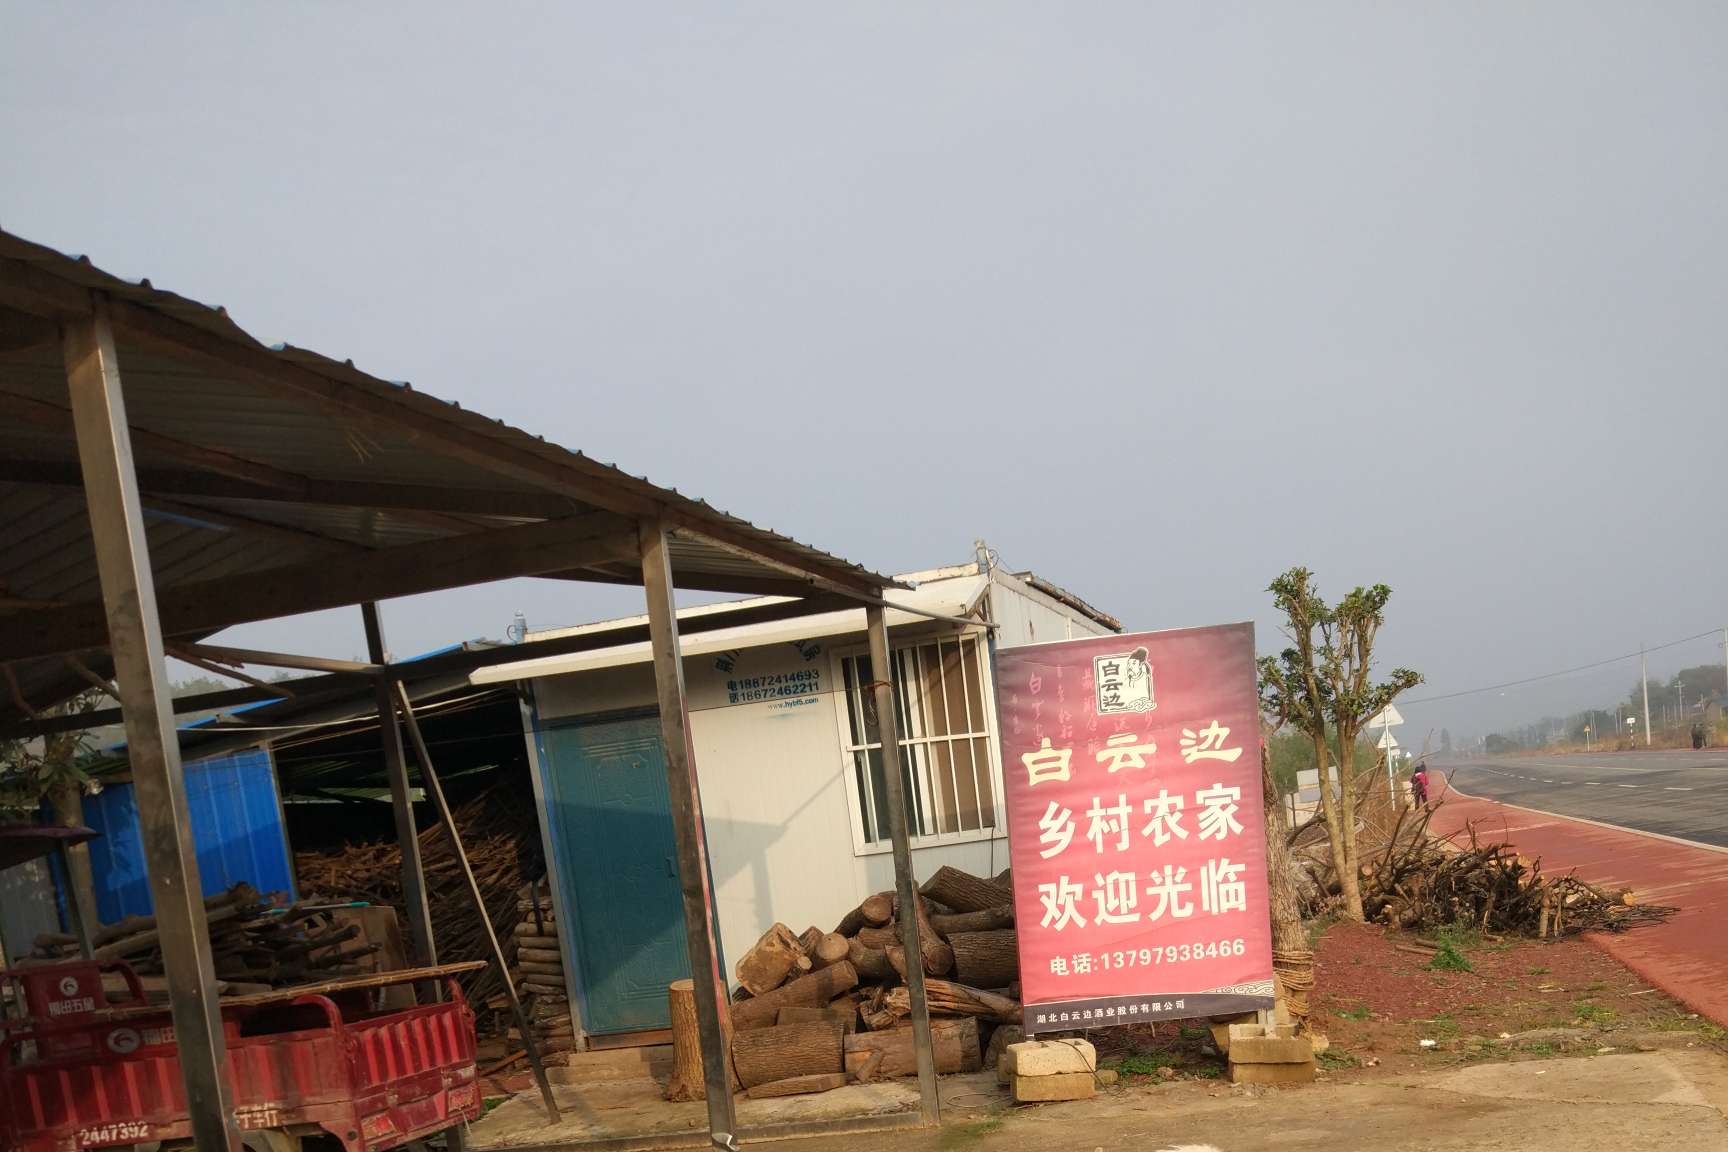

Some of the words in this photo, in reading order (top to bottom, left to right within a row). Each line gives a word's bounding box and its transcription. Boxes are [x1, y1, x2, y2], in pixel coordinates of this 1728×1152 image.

[1101, 660, 1125, 708] 白云边
[1021, 719, 1244, 787] 白云边
[1038, 783, 1245, 860] 乡村农家
[1038, 858, 1248, 932] 欢迎光临
[1049, 938, 1246, 976] 电话:13797938466
[1036, 999, 1187, 1025] 湖北白云边酒业股份有限公司
